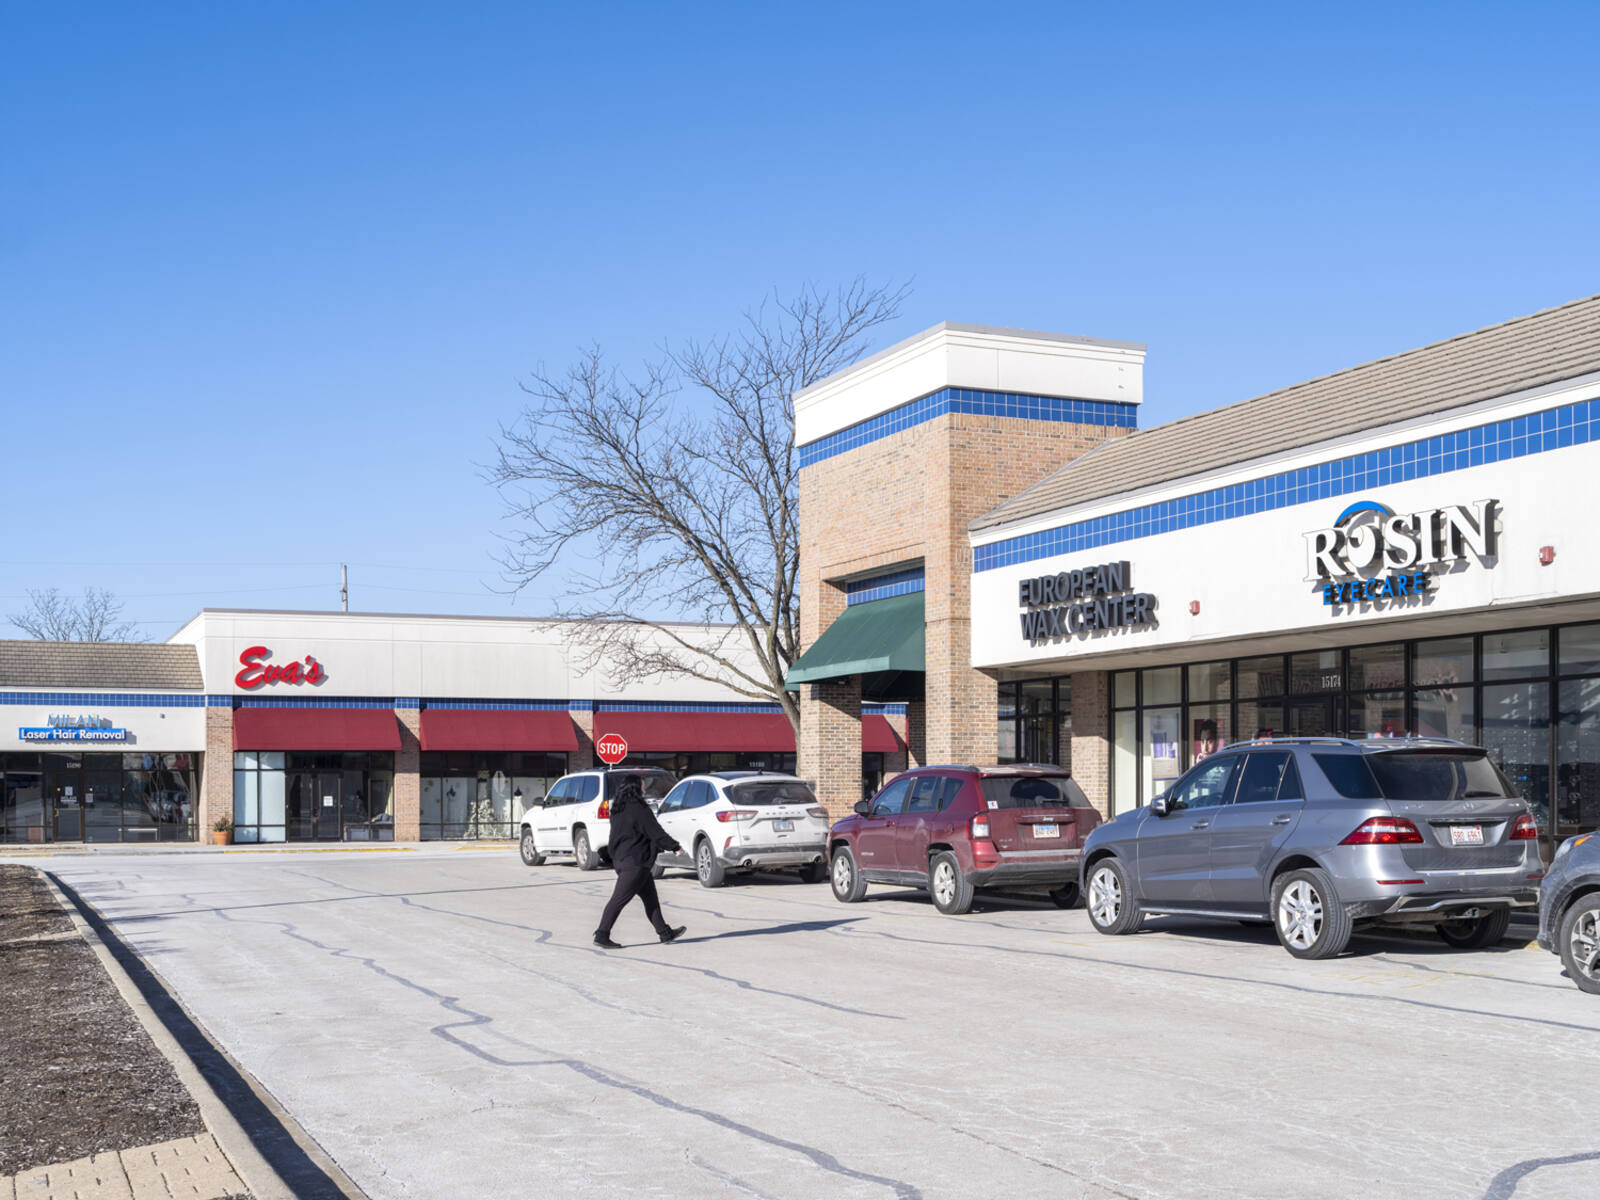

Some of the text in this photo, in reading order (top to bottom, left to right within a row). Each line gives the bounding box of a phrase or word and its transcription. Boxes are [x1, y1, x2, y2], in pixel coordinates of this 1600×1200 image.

[1302, 499, 1498, 582] ROSIN
[1019, 561, 1129, 607] EUROPEAN
[1323, 571, 1424, 605] EYECARE
[1020, 593, 1154, 640] WAX CENTER
[235, 645, 325, 689] Eva's
[20, 729, 125, 741] Laser Hair Removal
[47, 714, 100, 728] MILAN
[600, 742, 625, 755] STOP
